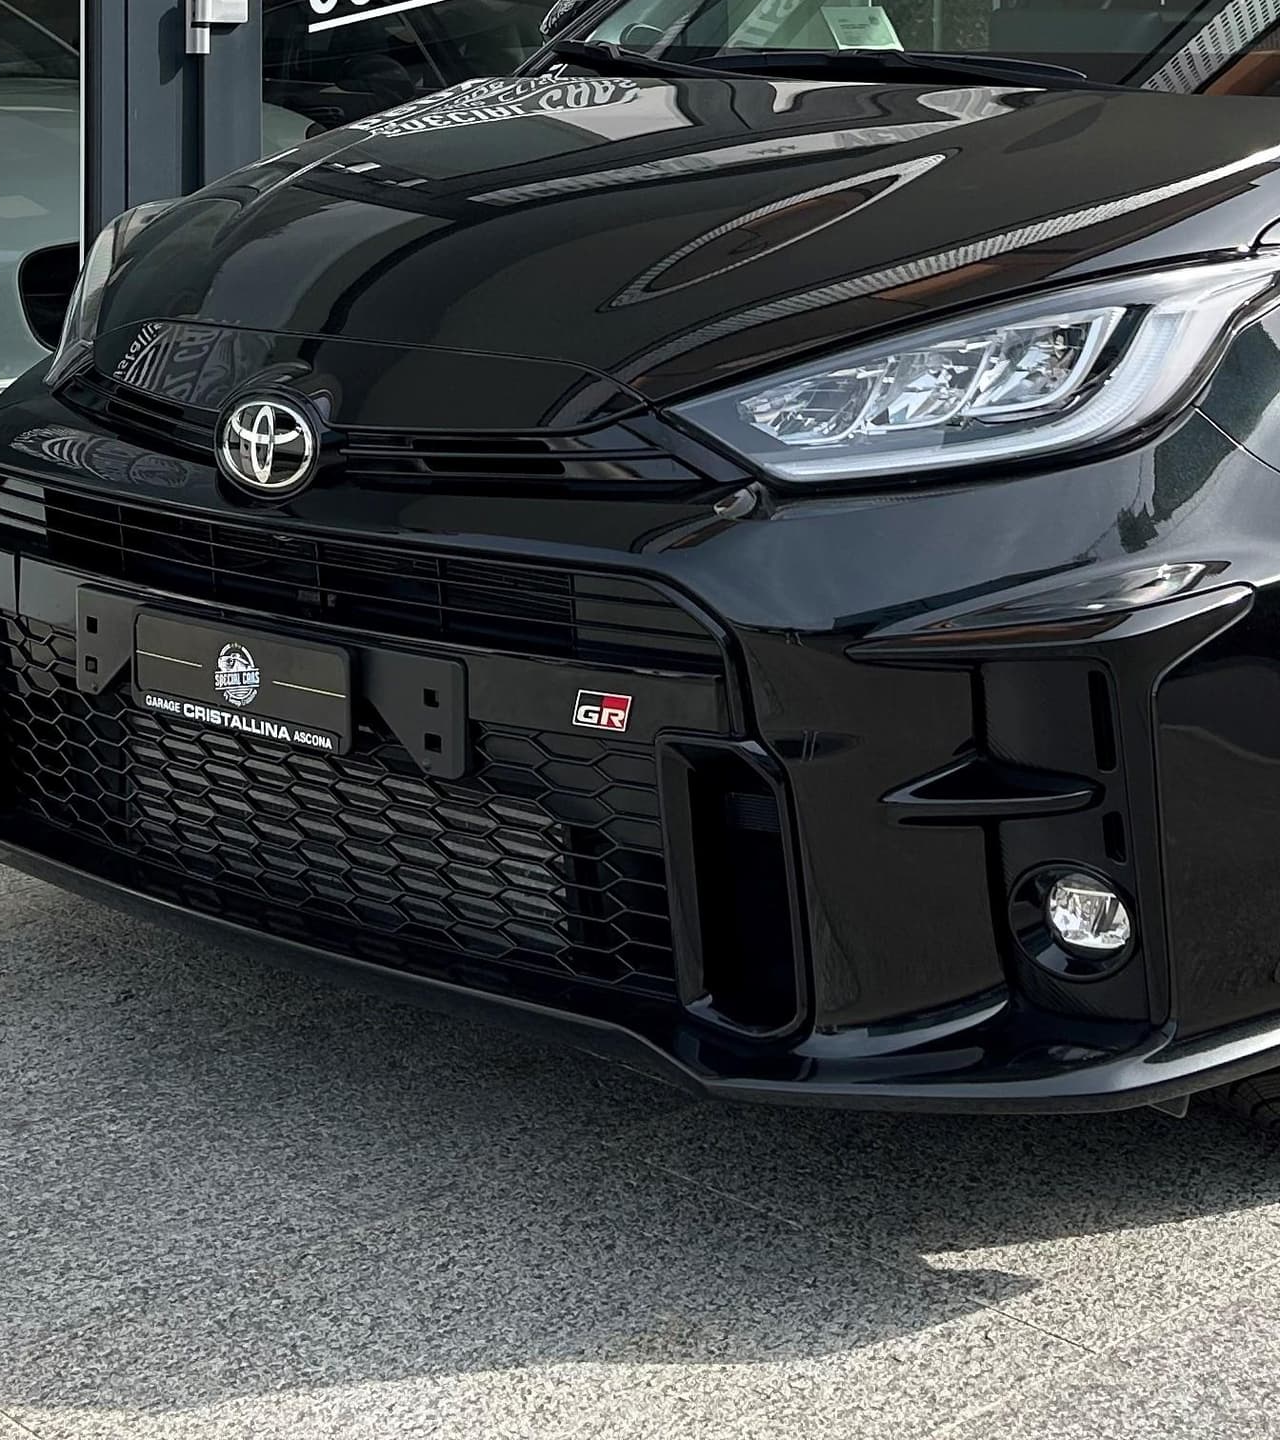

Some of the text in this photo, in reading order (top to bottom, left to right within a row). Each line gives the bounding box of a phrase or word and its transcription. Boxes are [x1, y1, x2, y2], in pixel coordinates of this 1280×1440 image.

[145, 694, 333, 750] GARAGE CRISTALLINA ASCONA
[576, 704, 626, 728] GR
